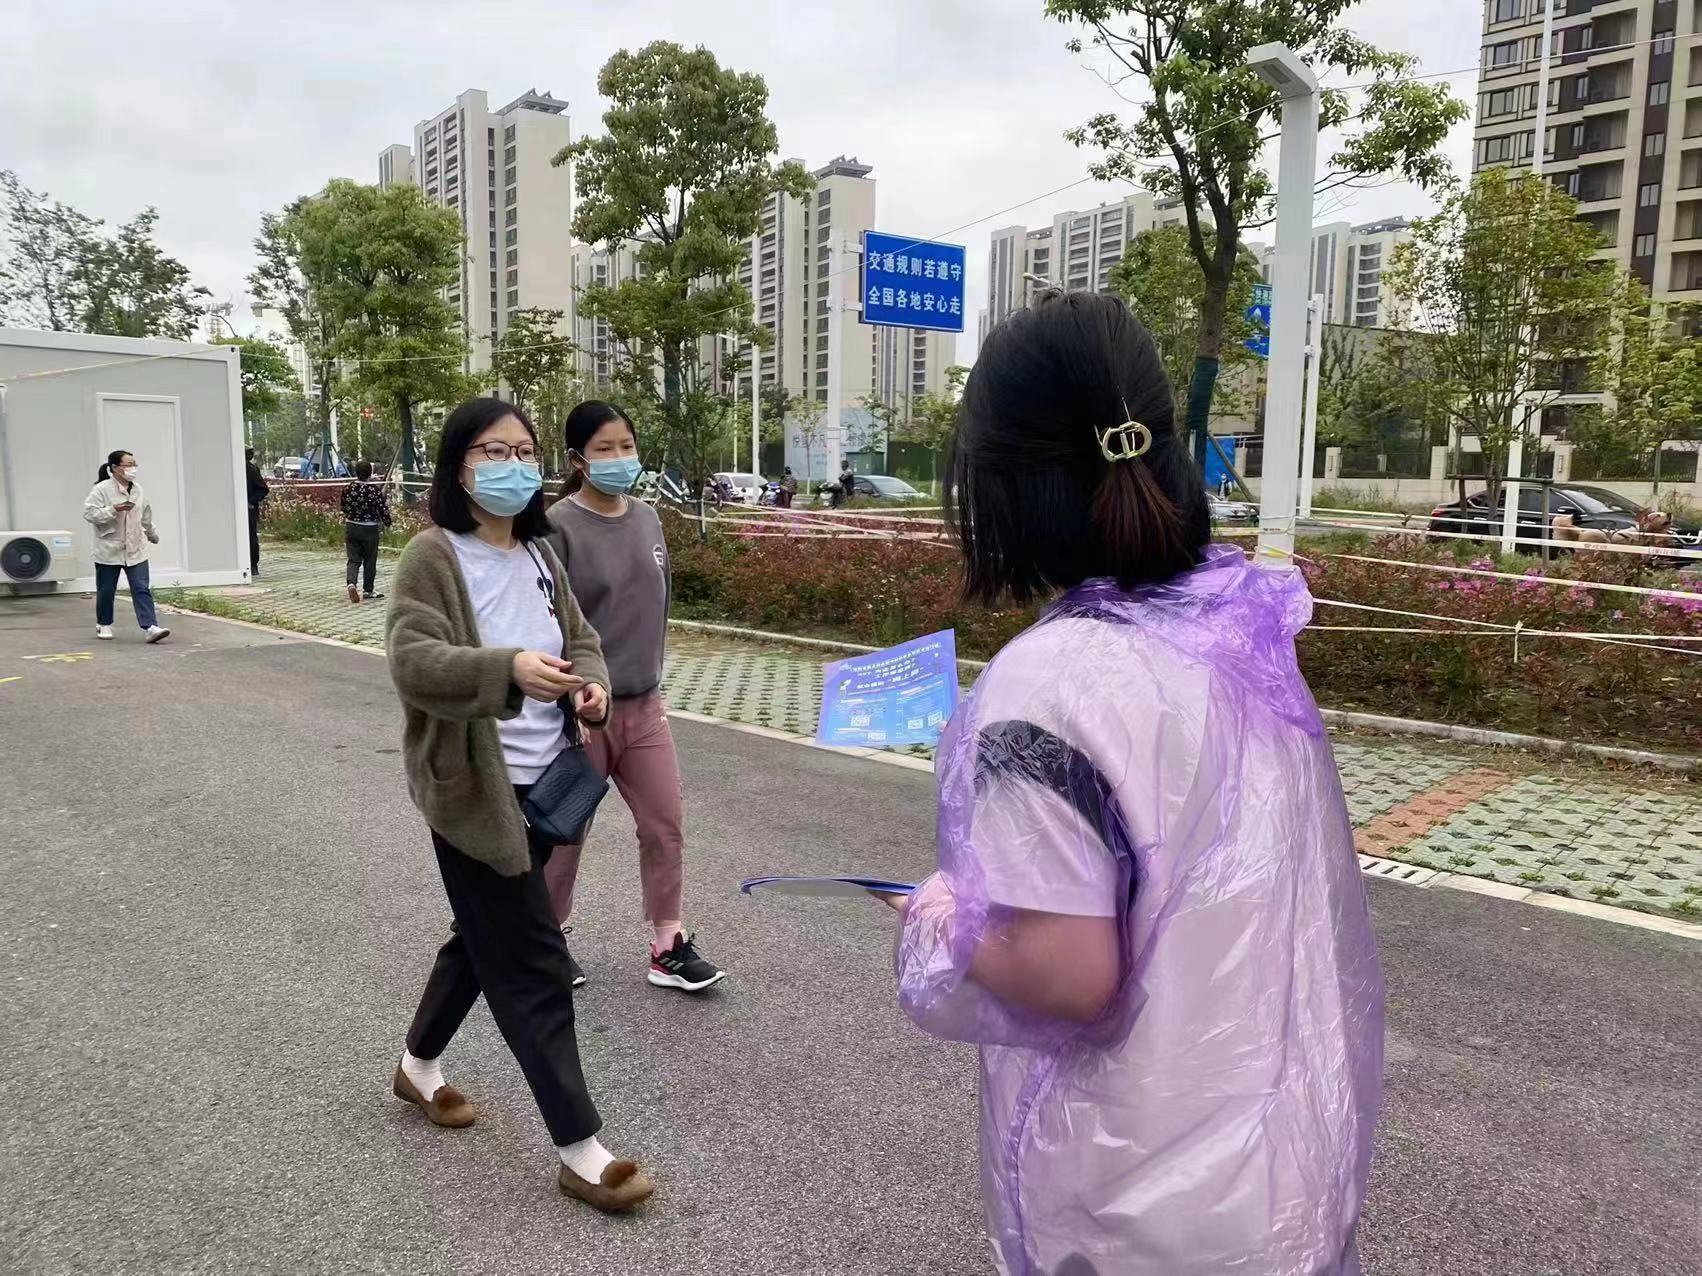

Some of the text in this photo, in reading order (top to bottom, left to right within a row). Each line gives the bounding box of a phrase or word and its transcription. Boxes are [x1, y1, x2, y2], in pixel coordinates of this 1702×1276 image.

[868, 250, 962, 281] 交通规则若遵守
[868, 286, 961, 315] 全国各地安心走
